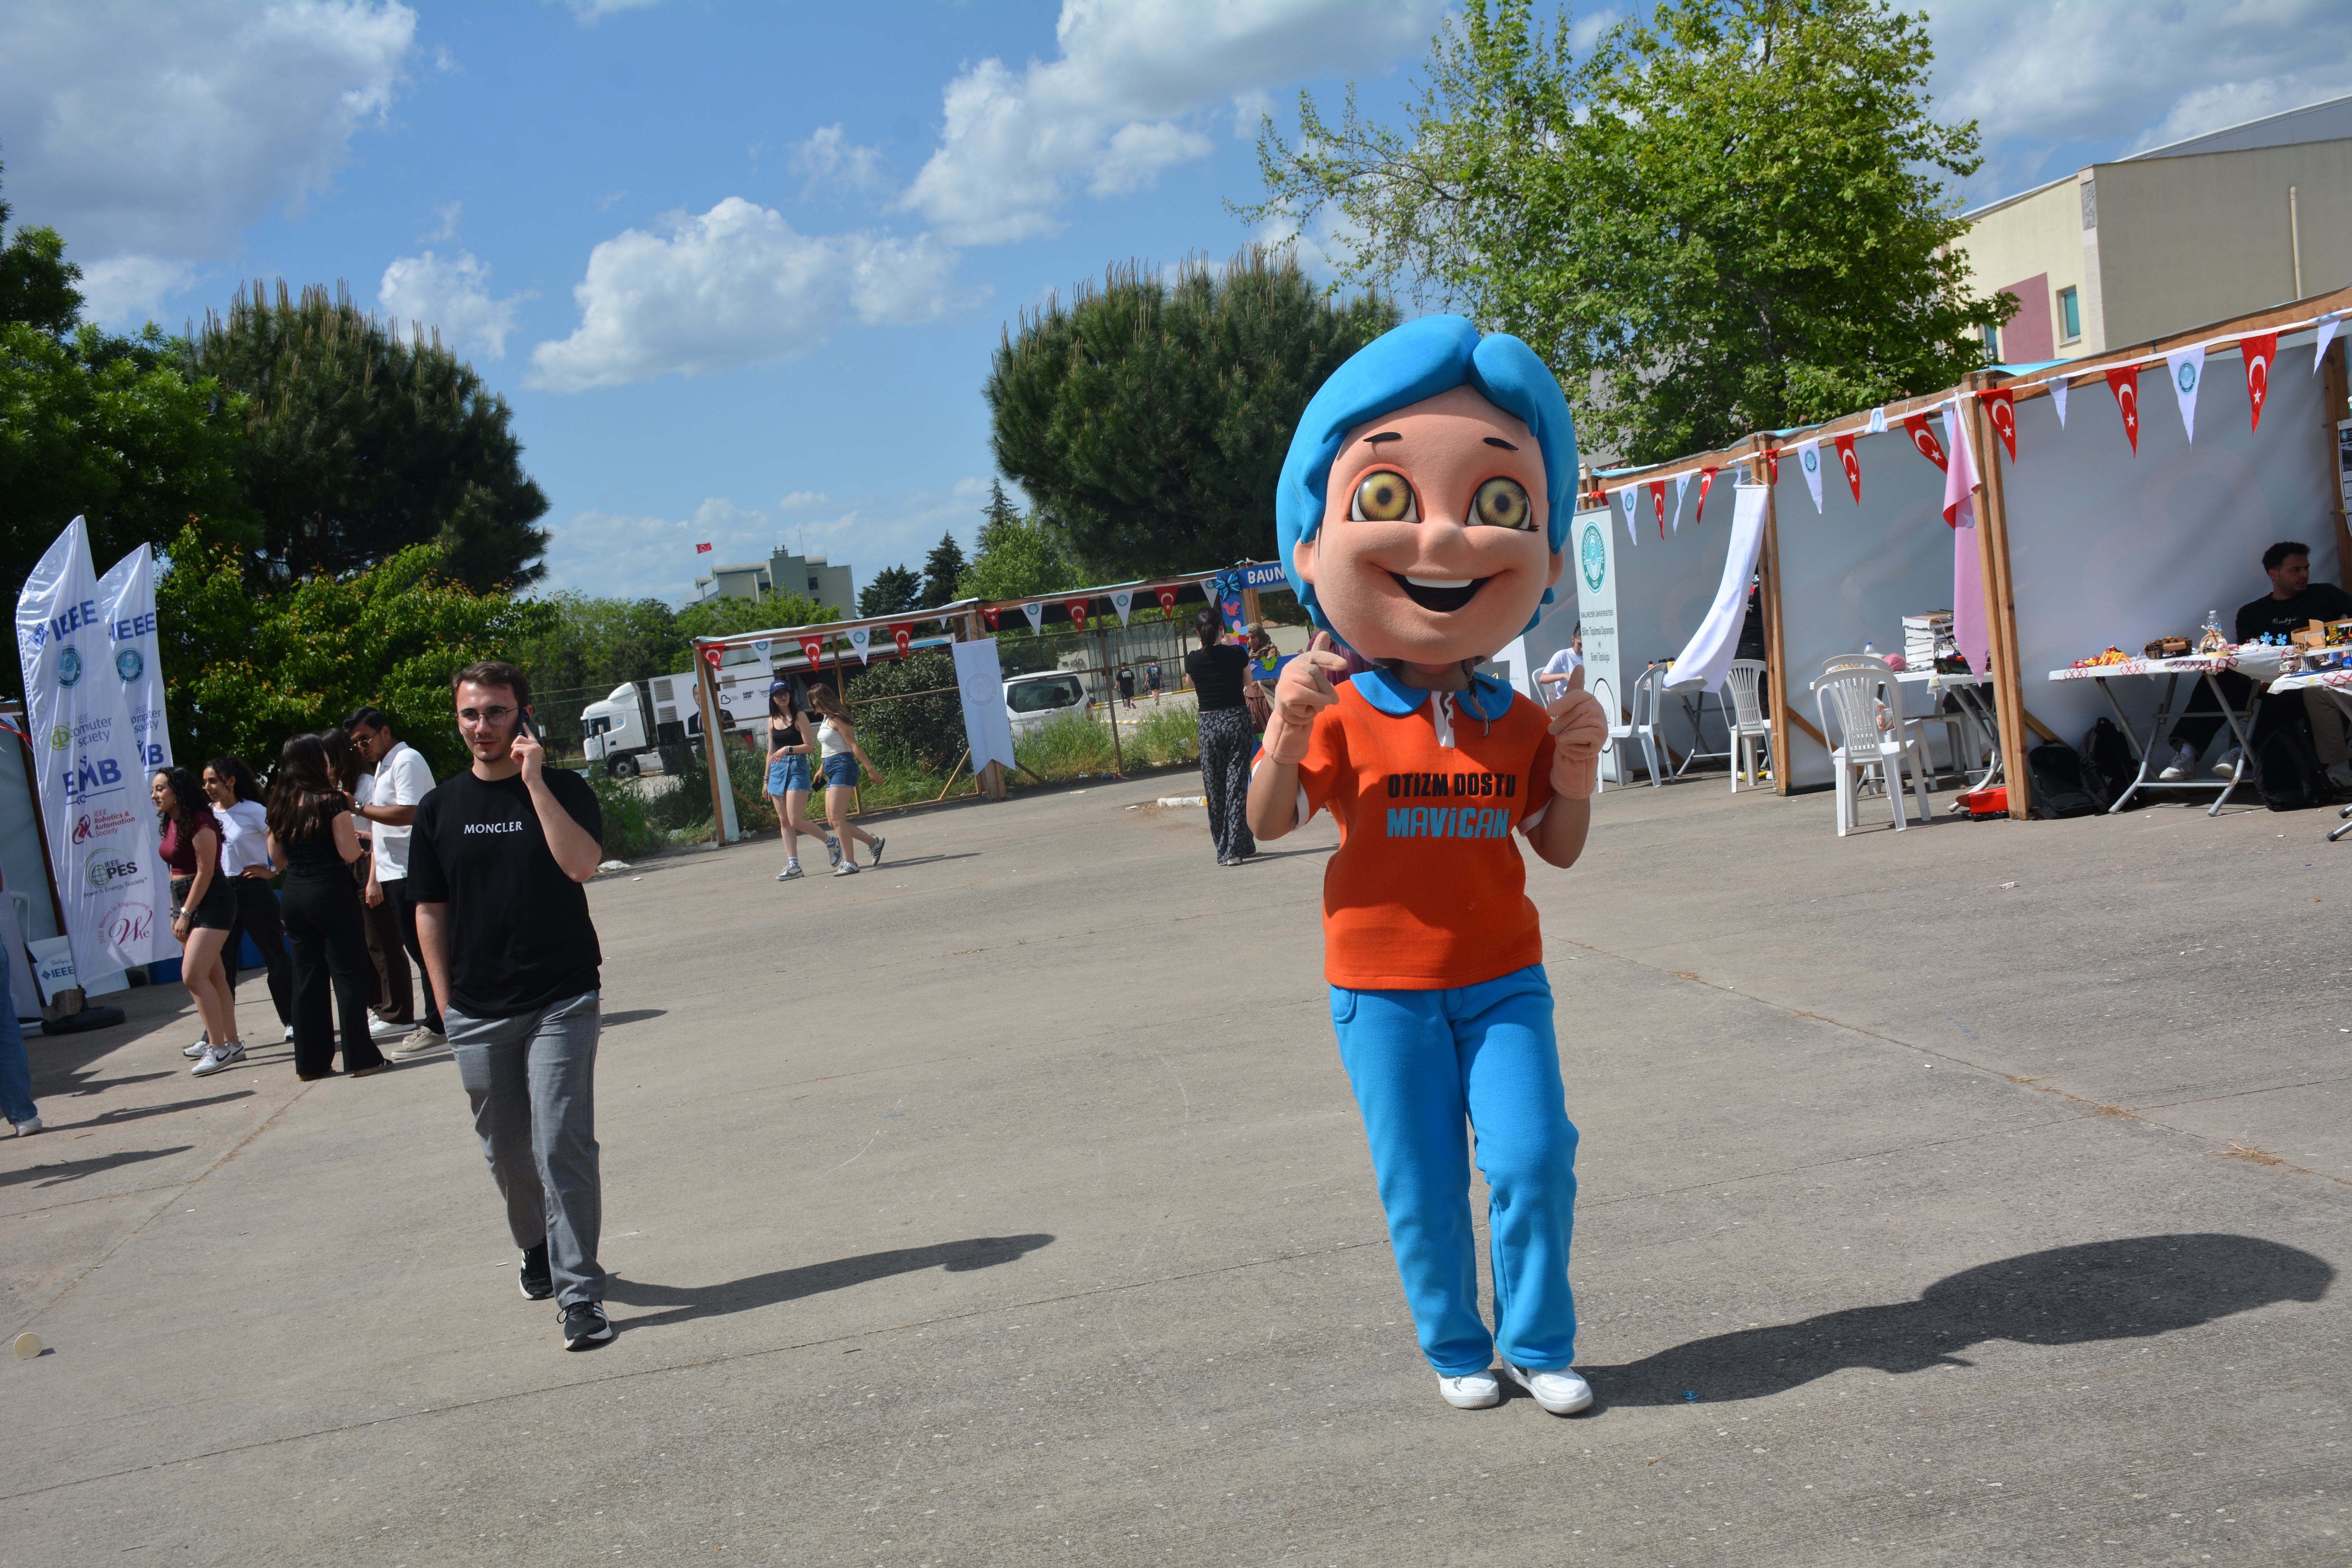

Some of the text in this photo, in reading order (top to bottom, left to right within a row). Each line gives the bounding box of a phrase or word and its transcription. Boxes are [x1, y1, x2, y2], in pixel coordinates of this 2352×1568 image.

[111, 612, 156, 641] IEEE
[62, 759, 122, 797] EMB
[1454, 773, 1516, 798] DOSTU
[94, 809, 107, 817] IEEE
[95, 813, 123, 824] Robotics
[95, 817, 135, 831] Automation
[464, 821, 523, 834] MONCLER
[96, 828, 118, 837] Society
[105, 859, 120, 868] IEEE
[106, 862, 138, 879] PES
[98, 910, 113, 928] Women
[118, 901, 150, 910] Engineering
[51, 966, 75, 978] IEEE
